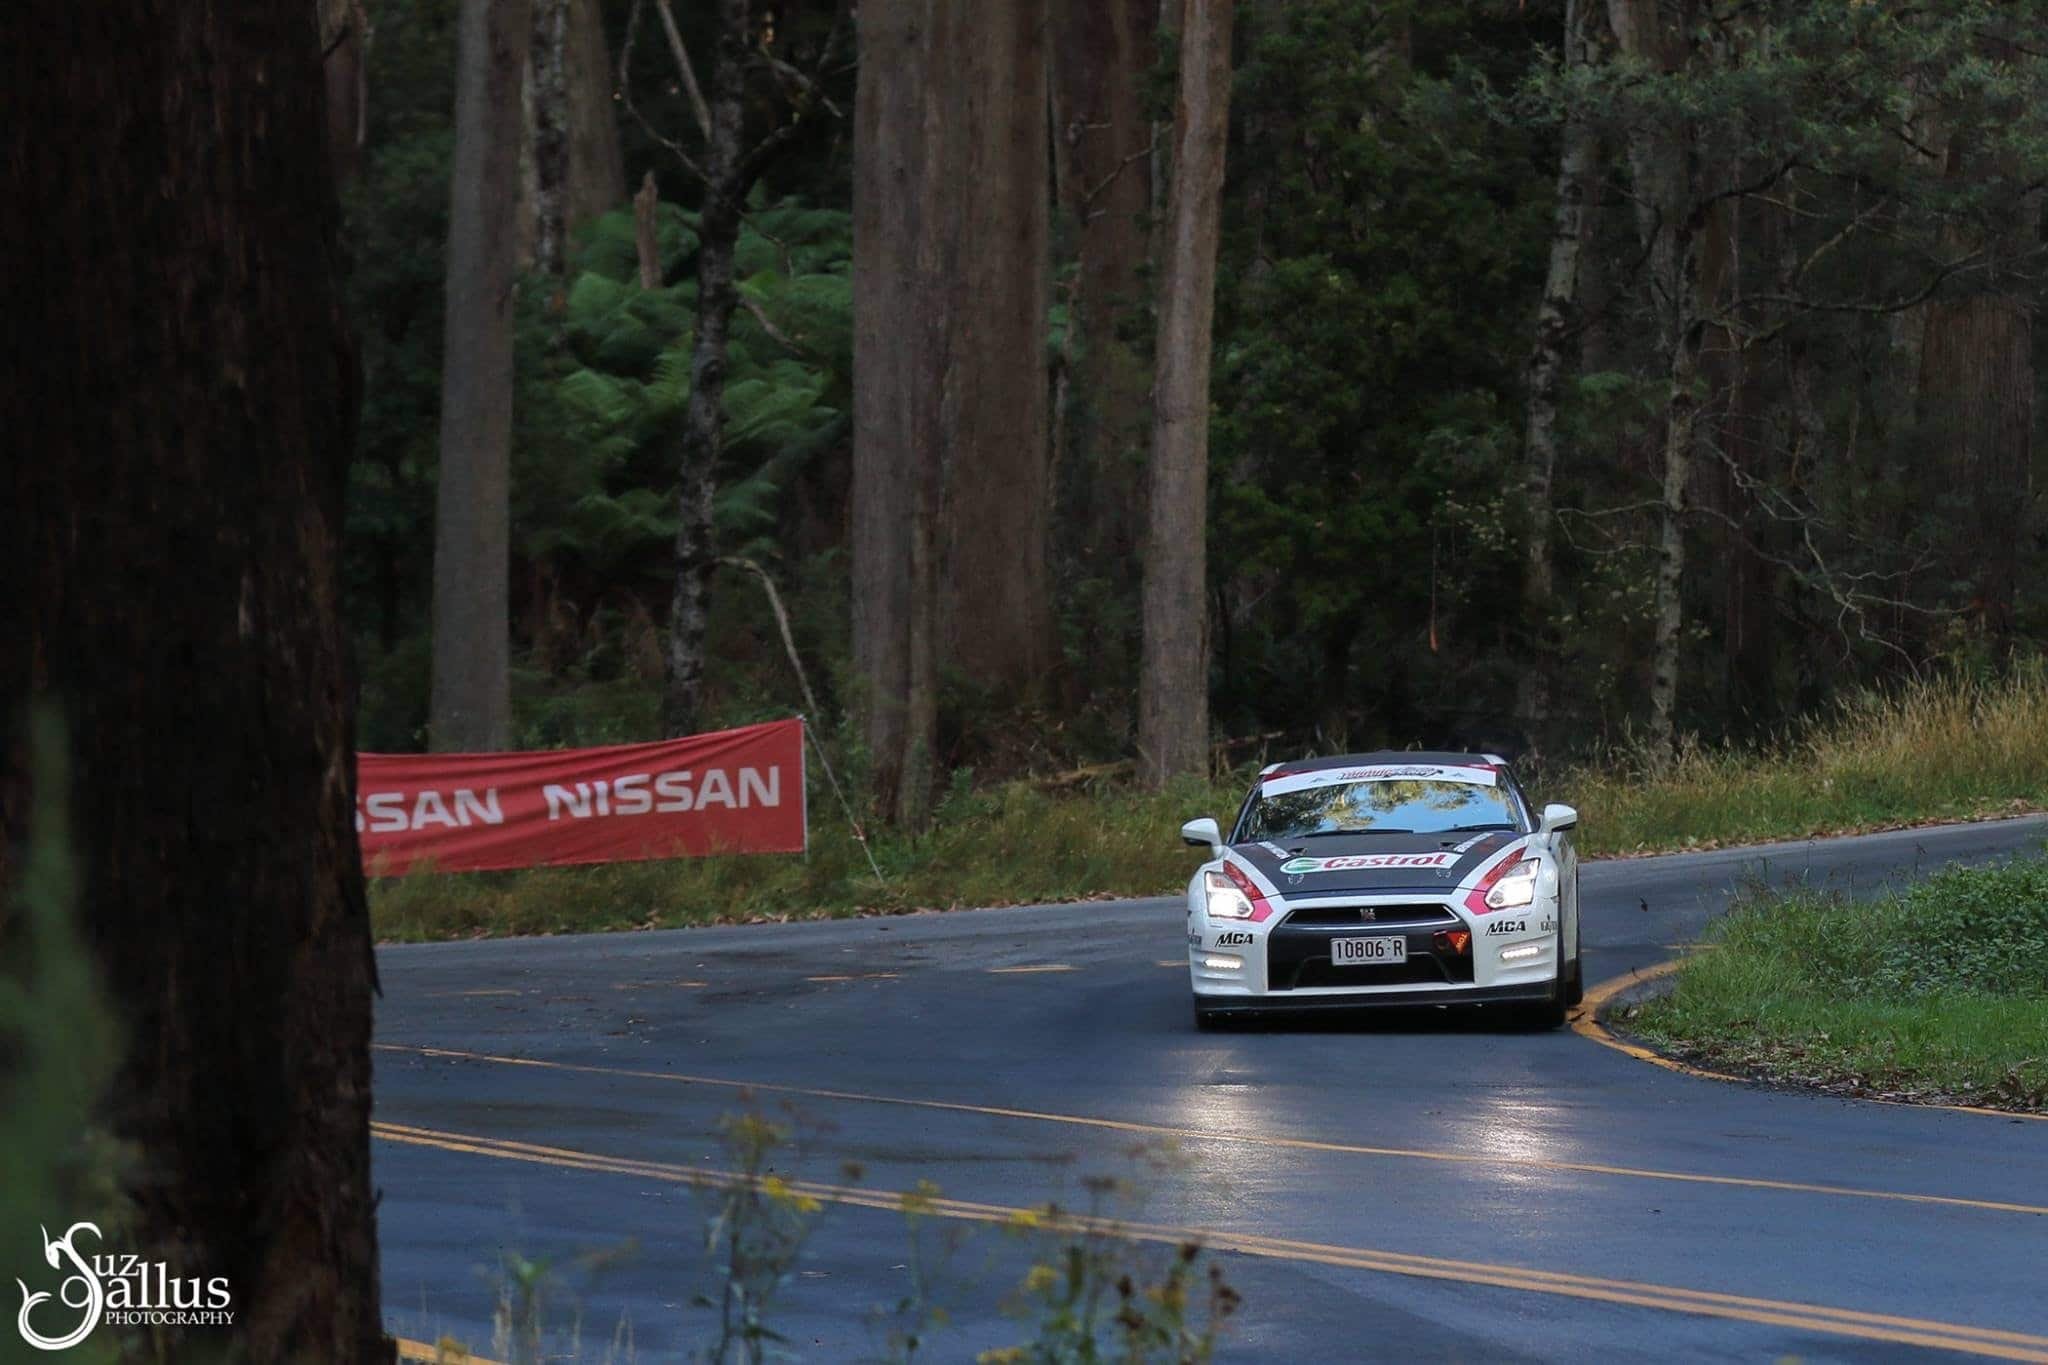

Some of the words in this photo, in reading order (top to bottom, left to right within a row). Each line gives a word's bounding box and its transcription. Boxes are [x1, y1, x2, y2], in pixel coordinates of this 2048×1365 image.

[355, 788, 503, 833] SAN
[542, 766, 780, 820] NISSAN
[1323, 854, 1447, 871] Castrol
[1485, 920, 1526, 936] MCA
[1215, 932, 1253, 947] MCA
